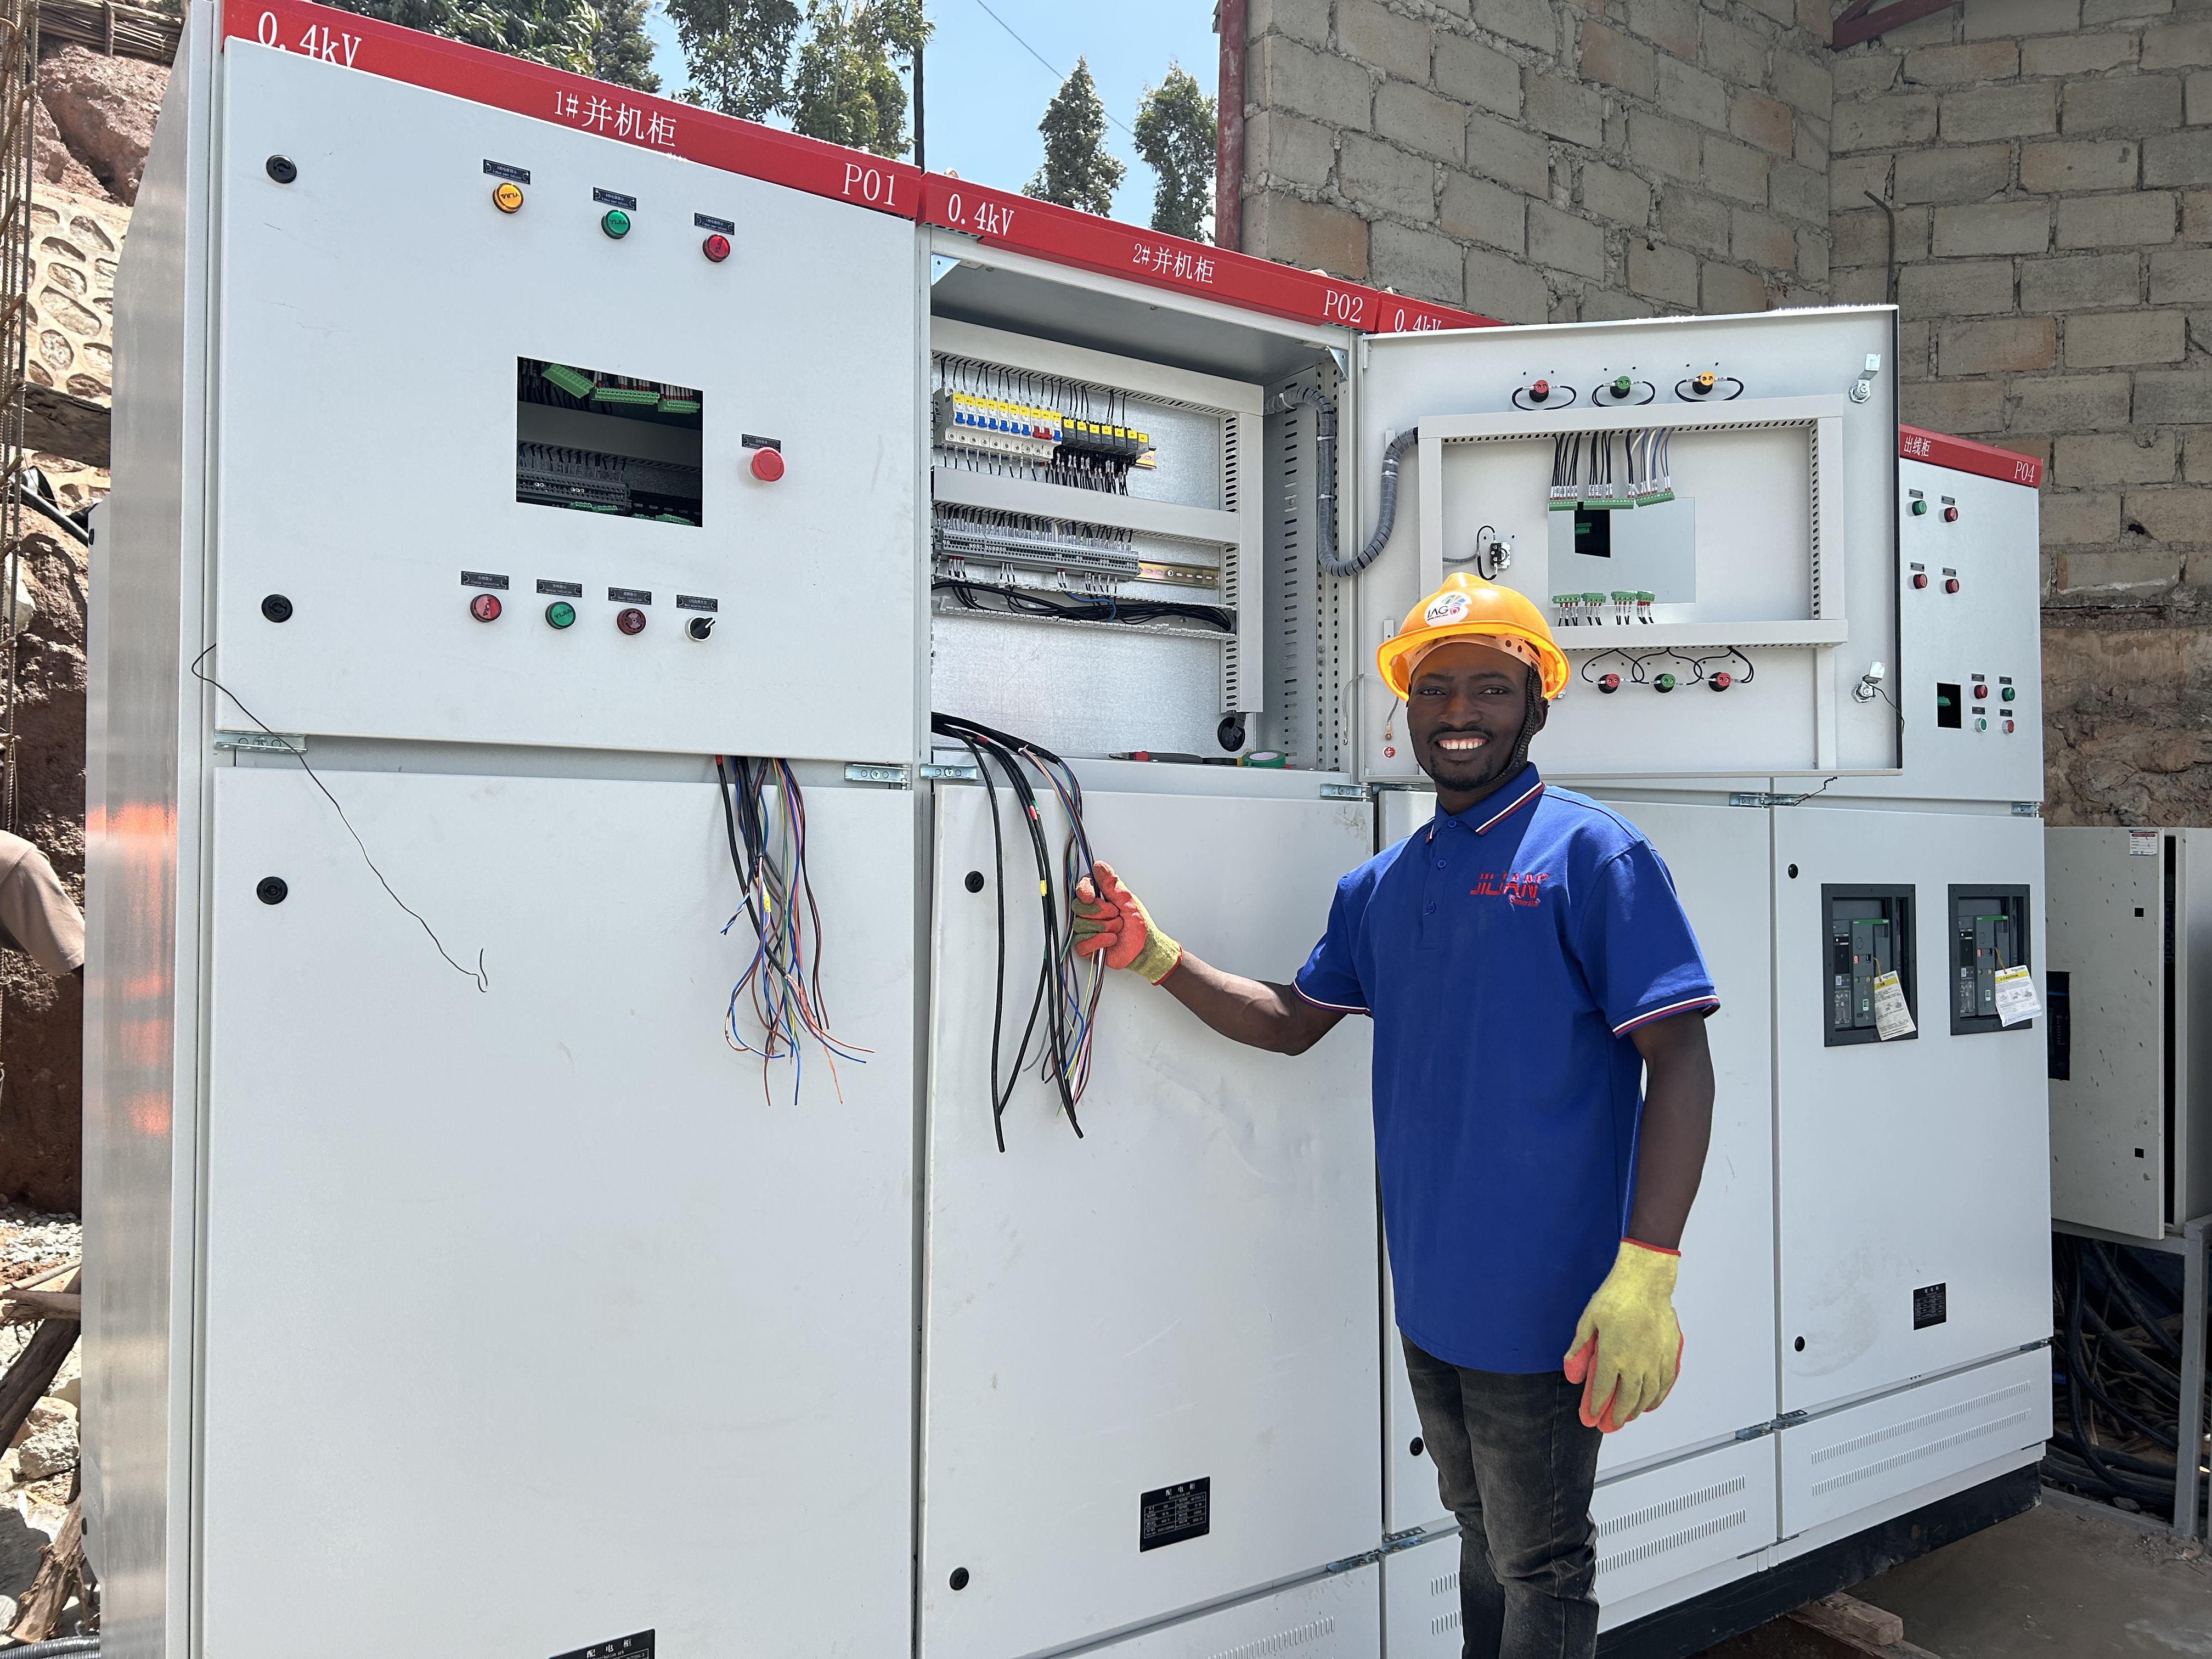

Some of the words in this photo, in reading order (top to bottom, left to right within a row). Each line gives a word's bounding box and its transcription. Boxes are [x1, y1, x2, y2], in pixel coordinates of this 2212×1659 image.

[258, 12, 362, 67] 0.4kV
[554, 91, 677, 147] 1#并机柜
[842, 162, 896, 206] P01
[948, 193, 1015, 236] 0.4kV
[1132, 243, 1215, 284] 2#并机柜
[1323, 289, 1363, 323] P02
[1903, 435, 1931, 457] 出线柜
[2014, 460, 2035, 483] P04
[1427, 606, 1449, 618] IAG
